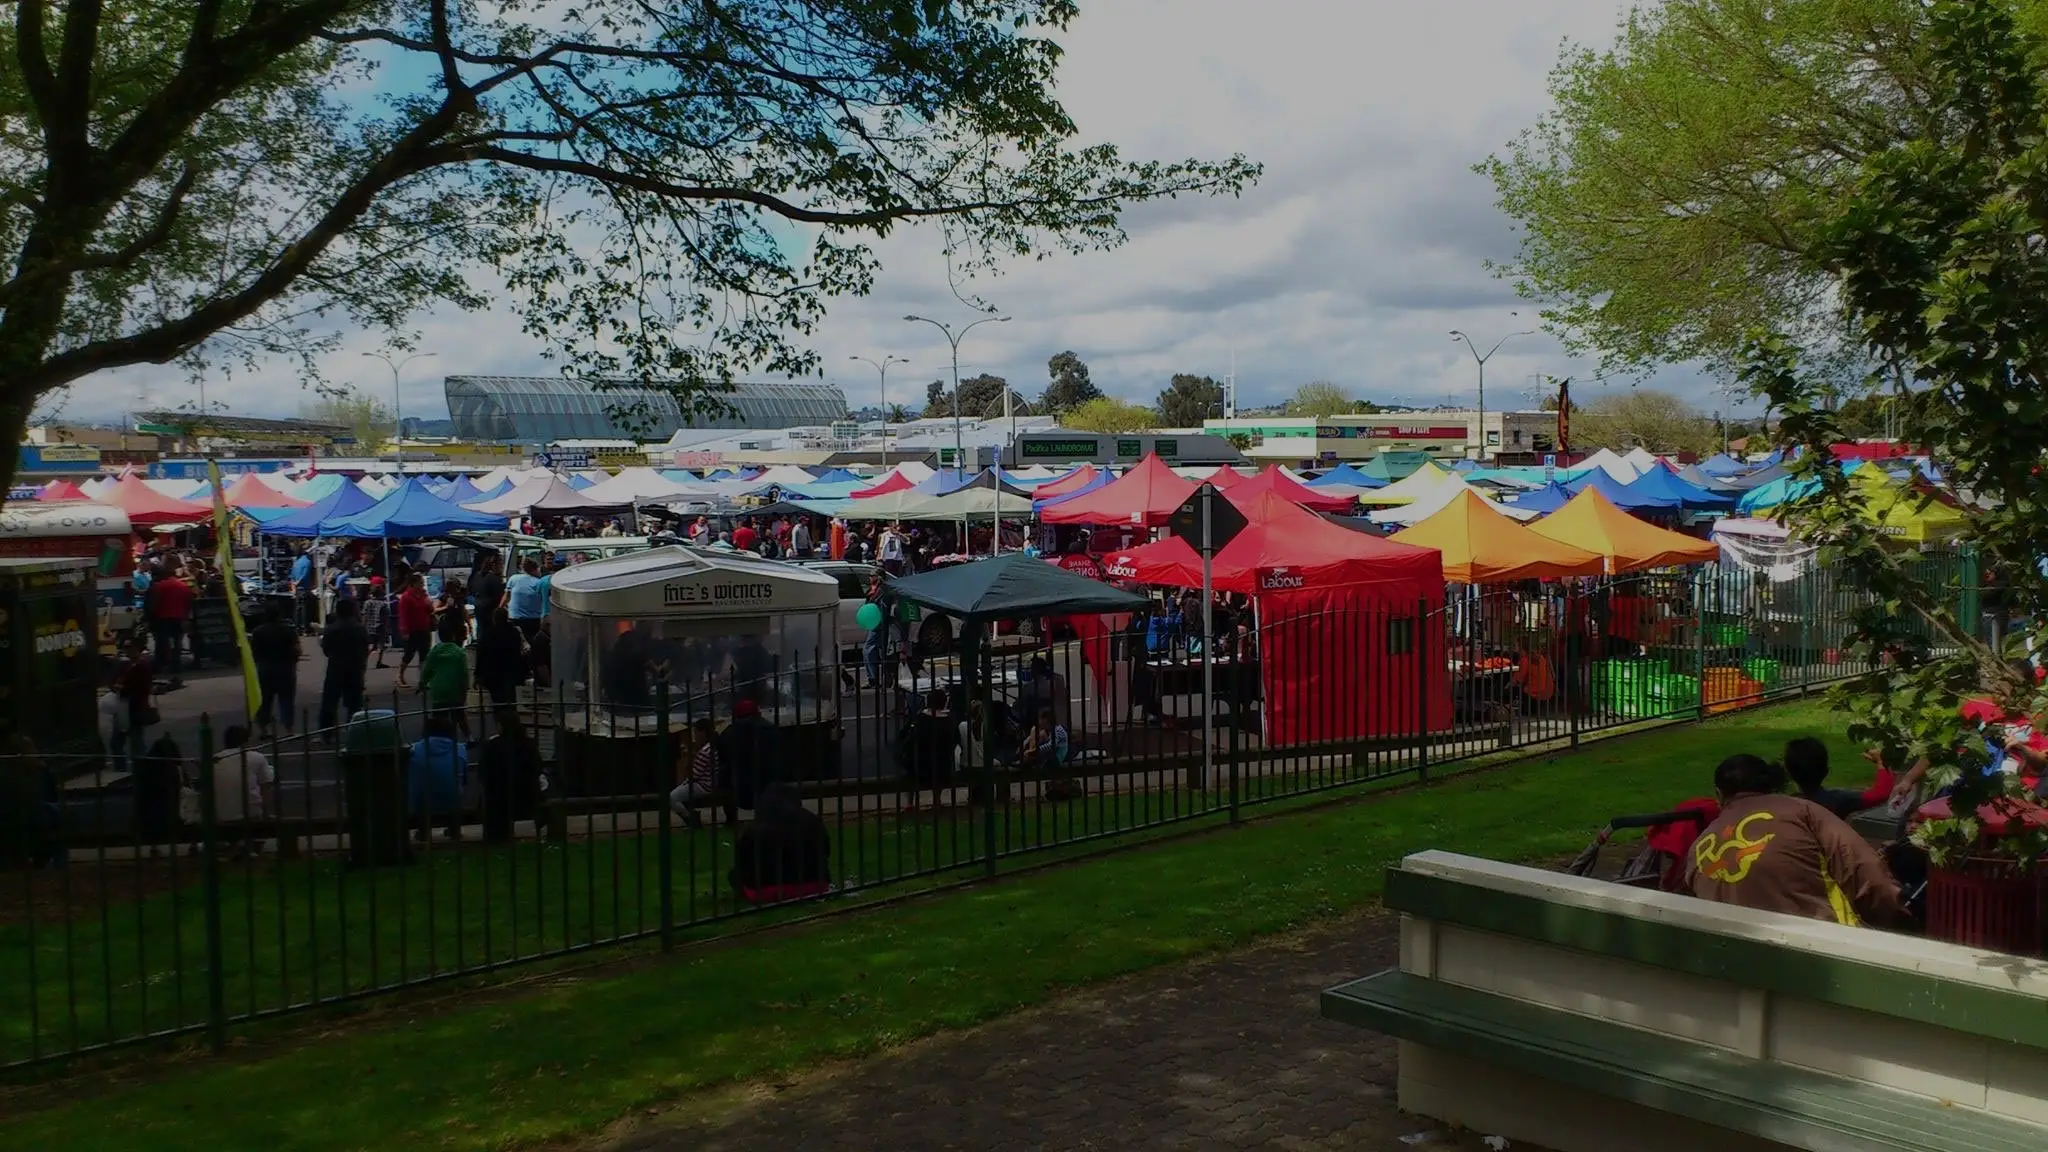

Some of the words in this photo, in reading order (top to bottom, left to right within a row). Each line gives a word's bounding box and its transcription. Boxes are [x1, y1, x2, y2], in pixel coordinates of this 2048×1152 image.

[1107, 563, 1137, 578] Labour
[1261, 575, 1304, 588] Labour
[714, 580, 772, 600] wieners
